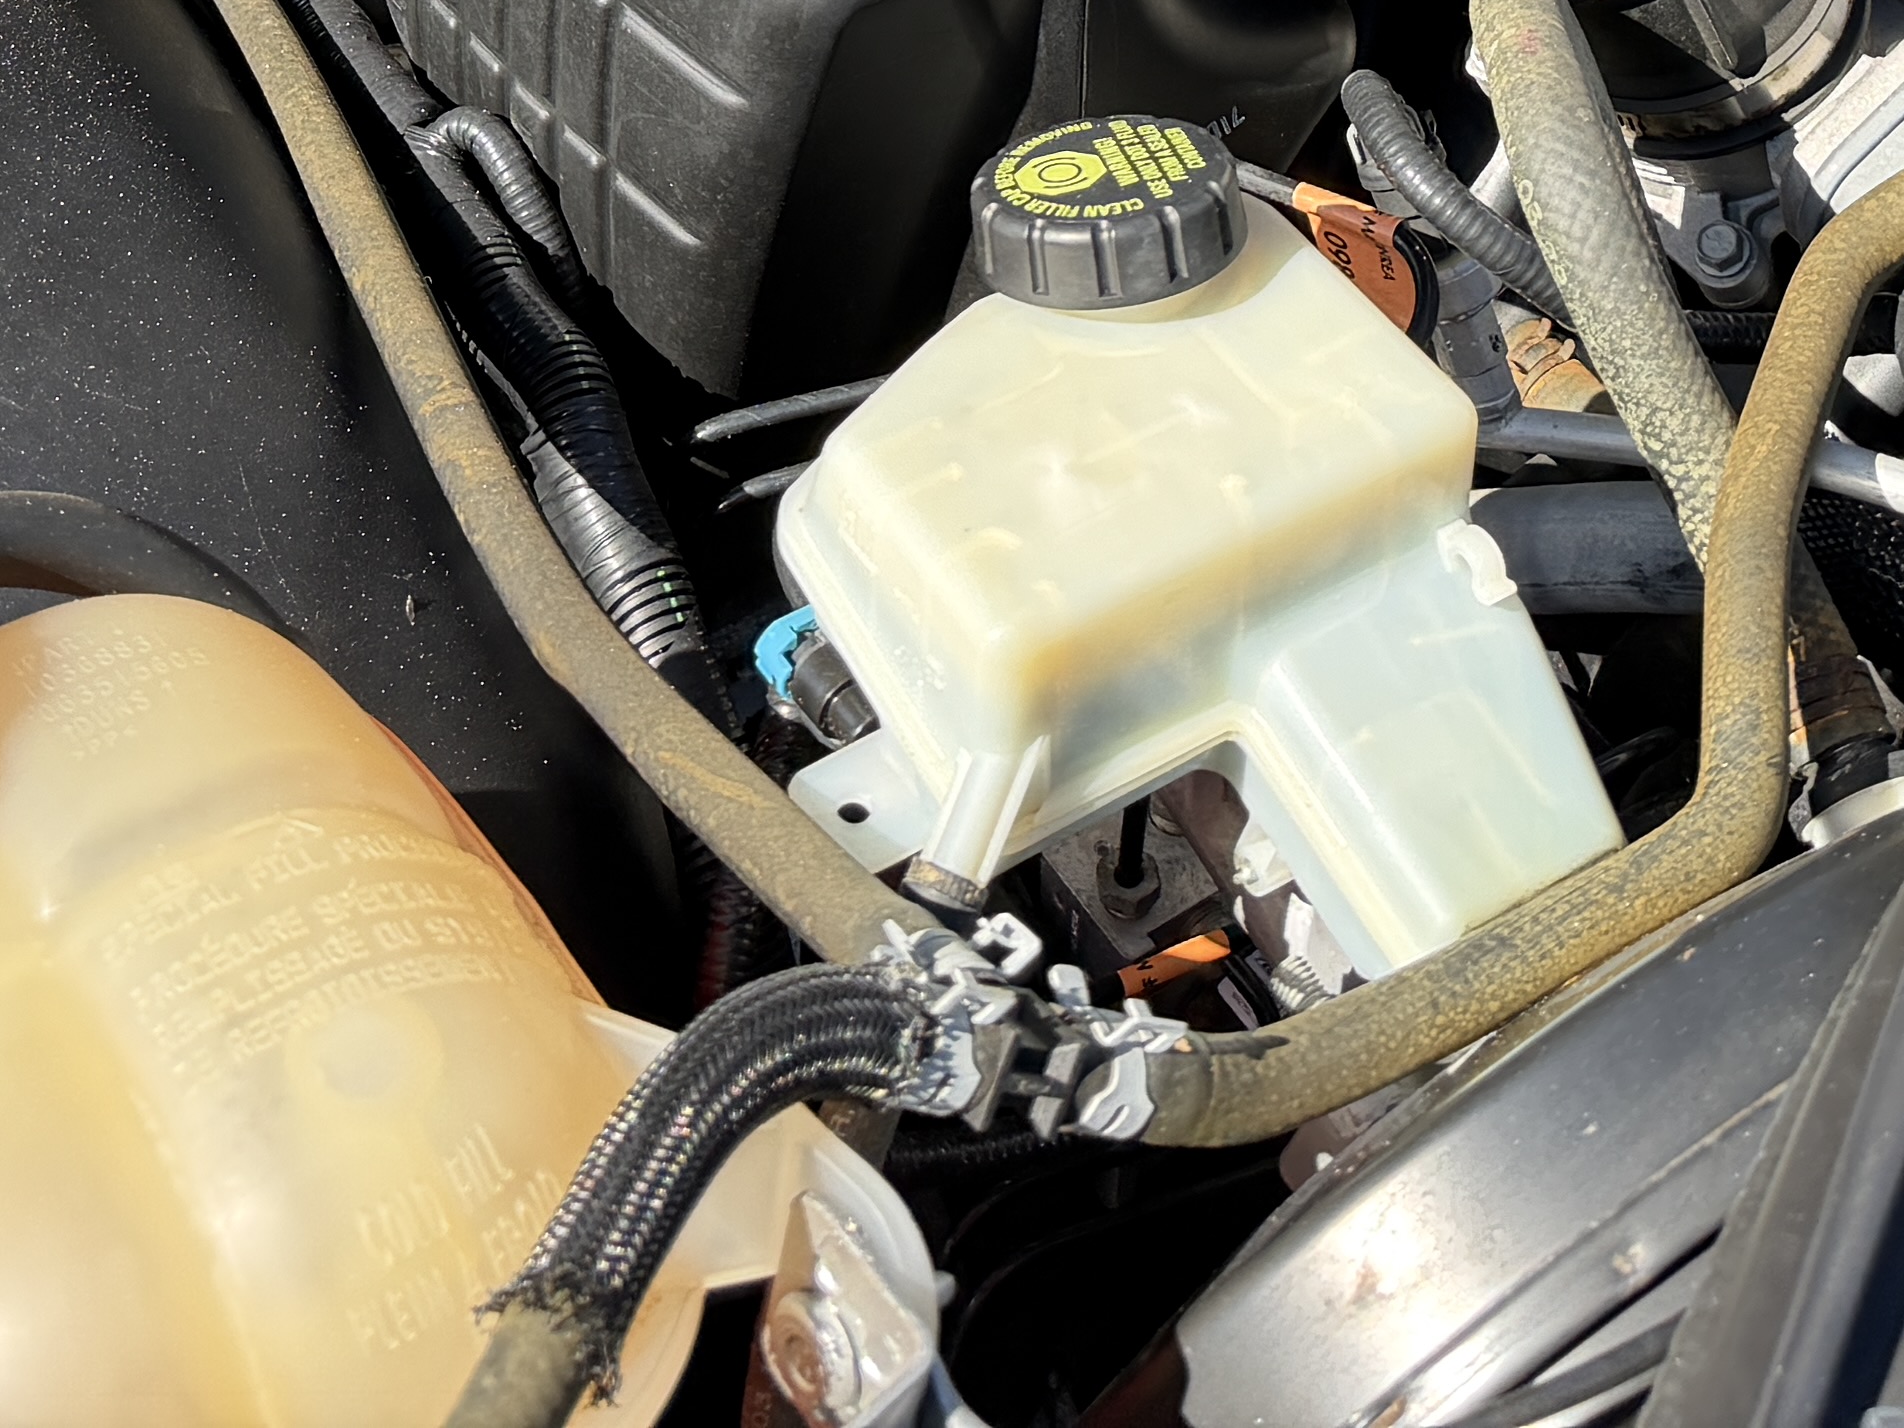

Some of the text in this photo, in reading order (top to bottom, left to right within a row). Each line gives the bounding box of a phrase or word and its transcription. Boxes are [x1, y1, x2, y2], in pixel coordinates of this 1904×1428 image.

[1123, 143, 1150, 161] DOT
[1154, 148, 1174, 158] A
[1164, 126, 1207, 169] CONTAINER
[1093, 137, 1139, 187] WARNING!
[1134, 159, 1163, 181] ONLY
[1158, 155, 1189, 182] FROM
[993, 157, 1022, 191] BEFORE
[999, 186, 1032, 208] CAP
[1147, 179, 1173, 199] USE
[1024, 196, 1081, 219] FILLER
[1083, 197, 1145, 219] CLEAN
[245, 848, 330, 892] FILL
